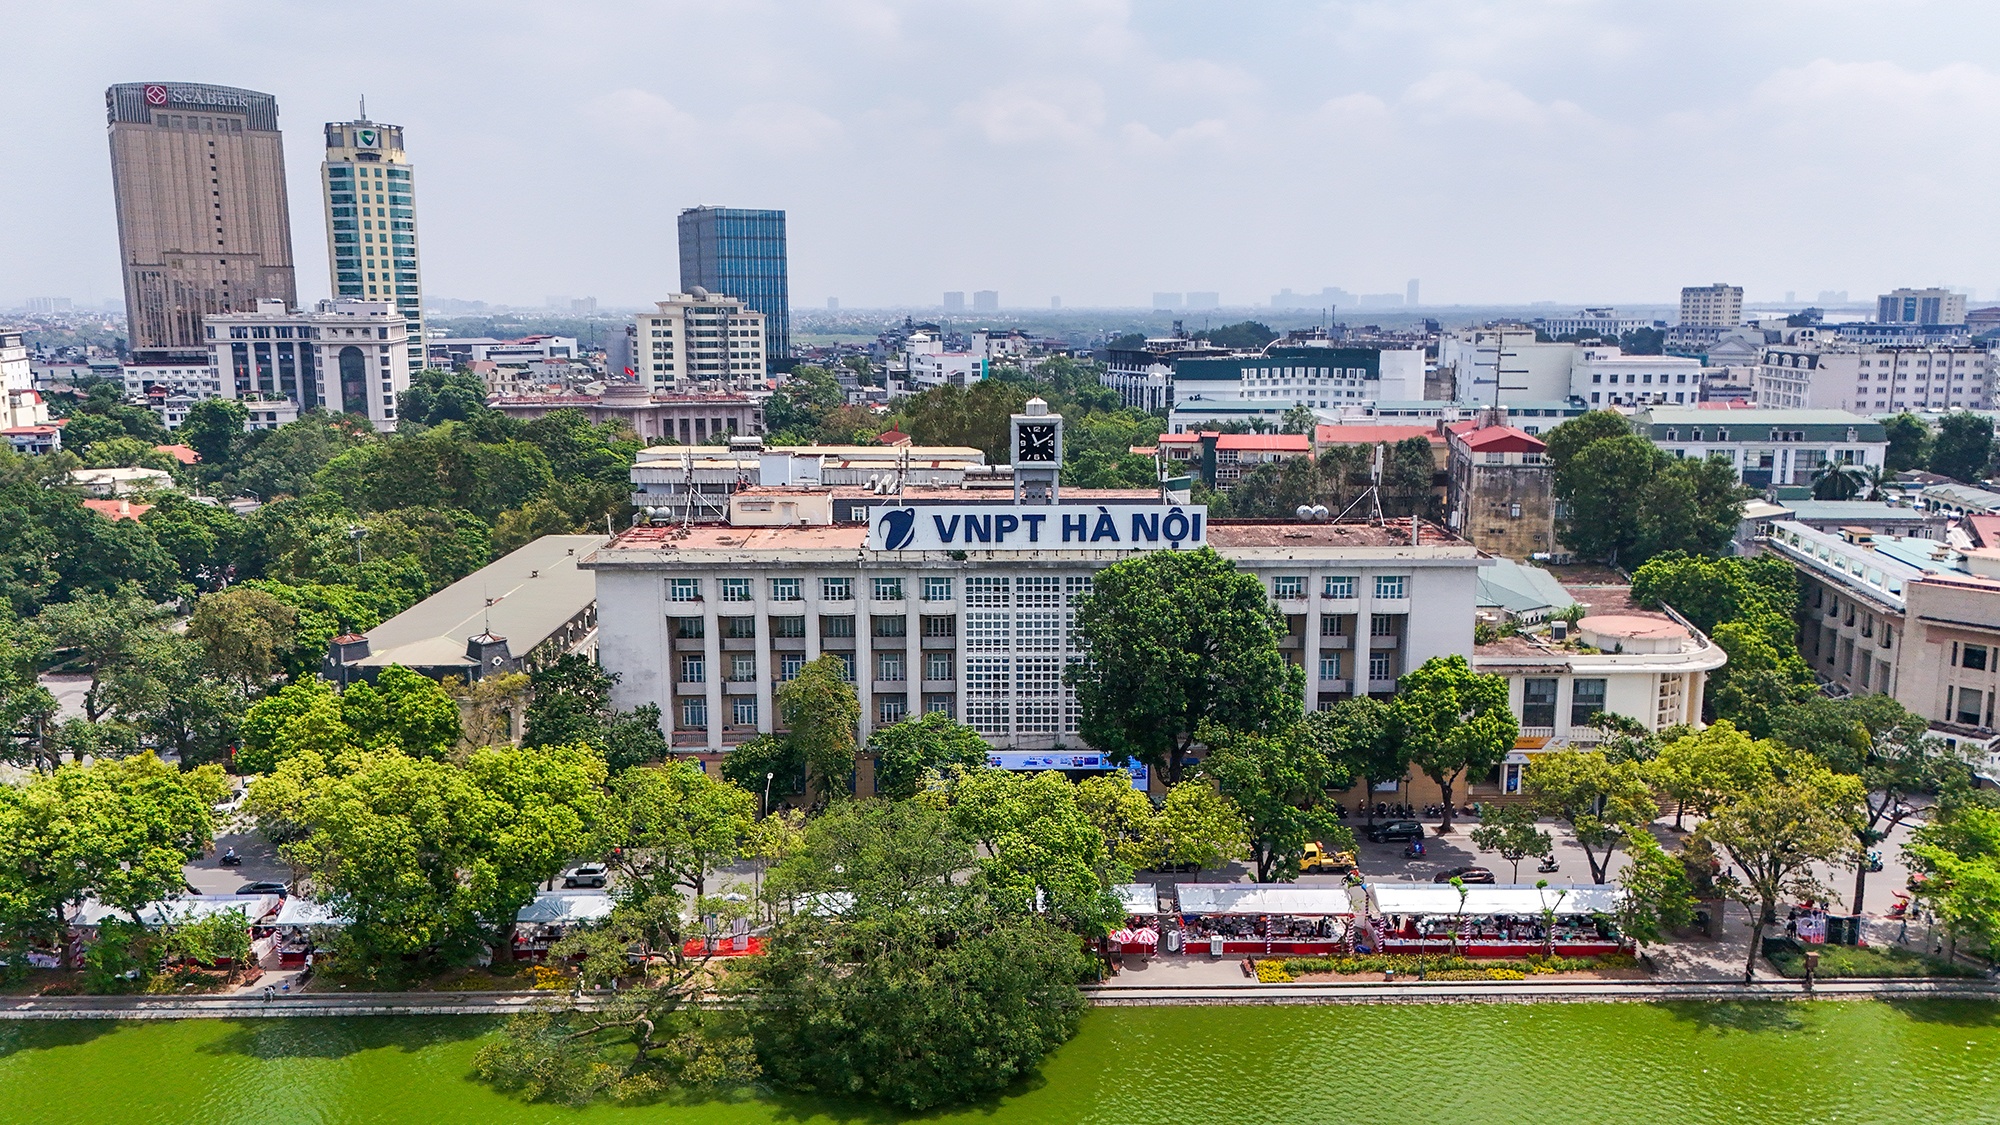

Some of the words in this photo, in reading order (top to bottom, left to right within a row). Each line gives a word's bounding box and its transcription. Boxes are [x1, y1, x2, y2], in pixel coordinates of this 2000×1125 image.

[172, 90, 248, 107] SeABank
[933, 514, 1046, 543] VNPT
[1062, 506, 1120, 542] HÀ
[1132, 507, 1201, 549] NỘI
